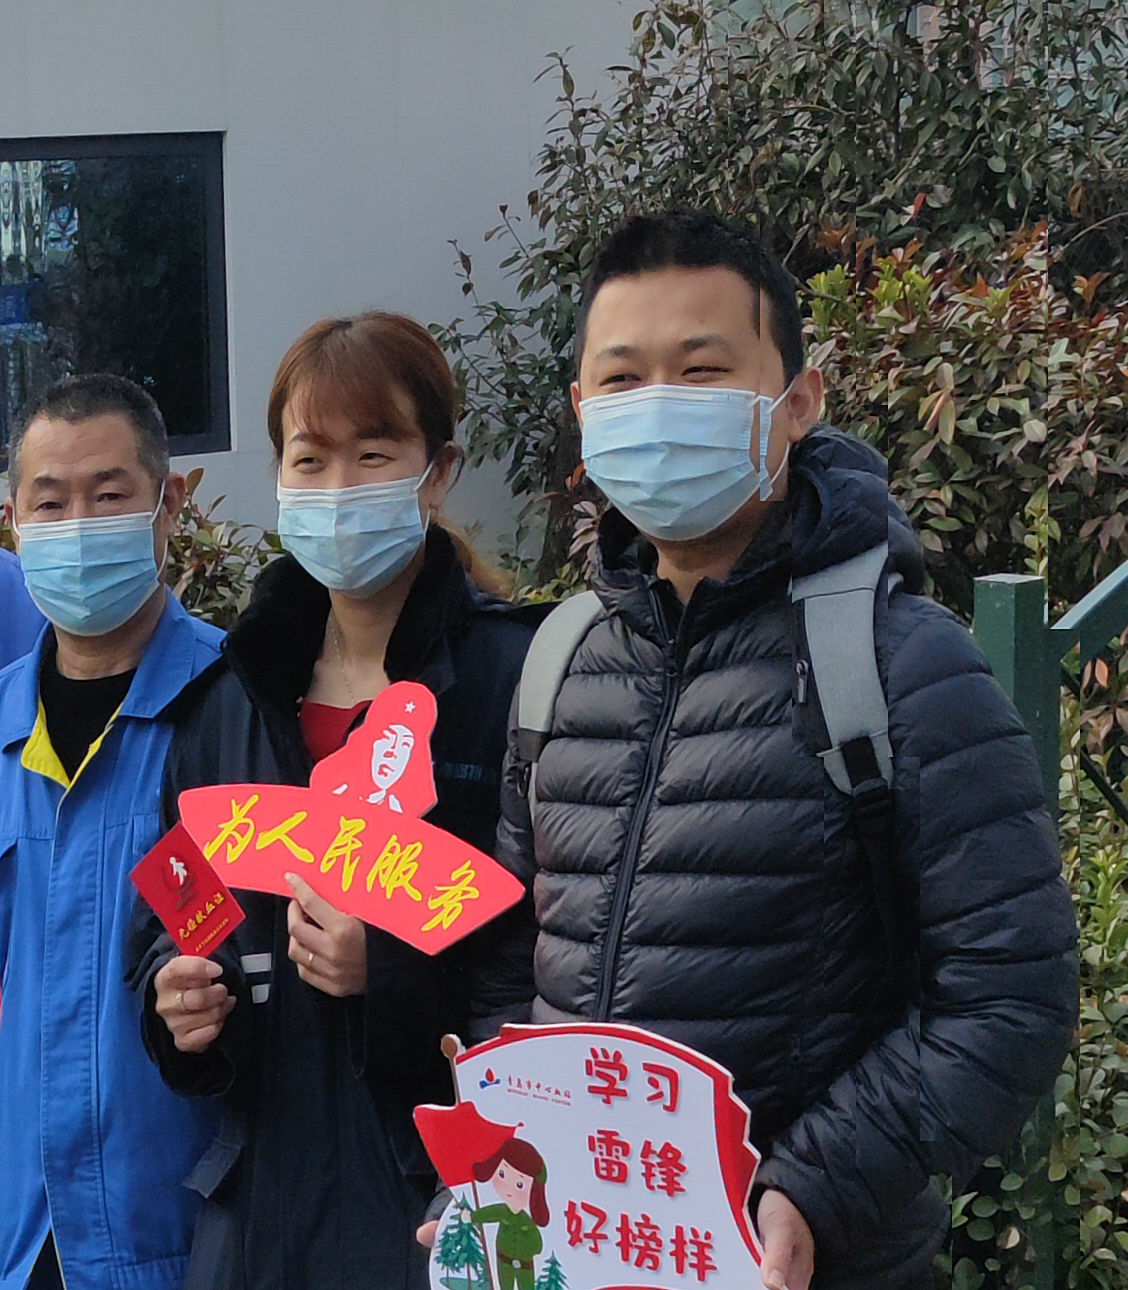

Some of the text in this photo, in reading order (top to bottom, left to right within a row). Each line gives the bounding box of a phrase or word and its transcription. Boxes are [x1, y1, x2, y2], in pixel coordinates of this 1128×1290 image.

[203, 794, 480, 932] 为人民服务
[584, 1046, 680, 1113] 学习
[588, 1129, 688, 1198] 雷锋
[563, 1199, 718, 1283] 好榜样
